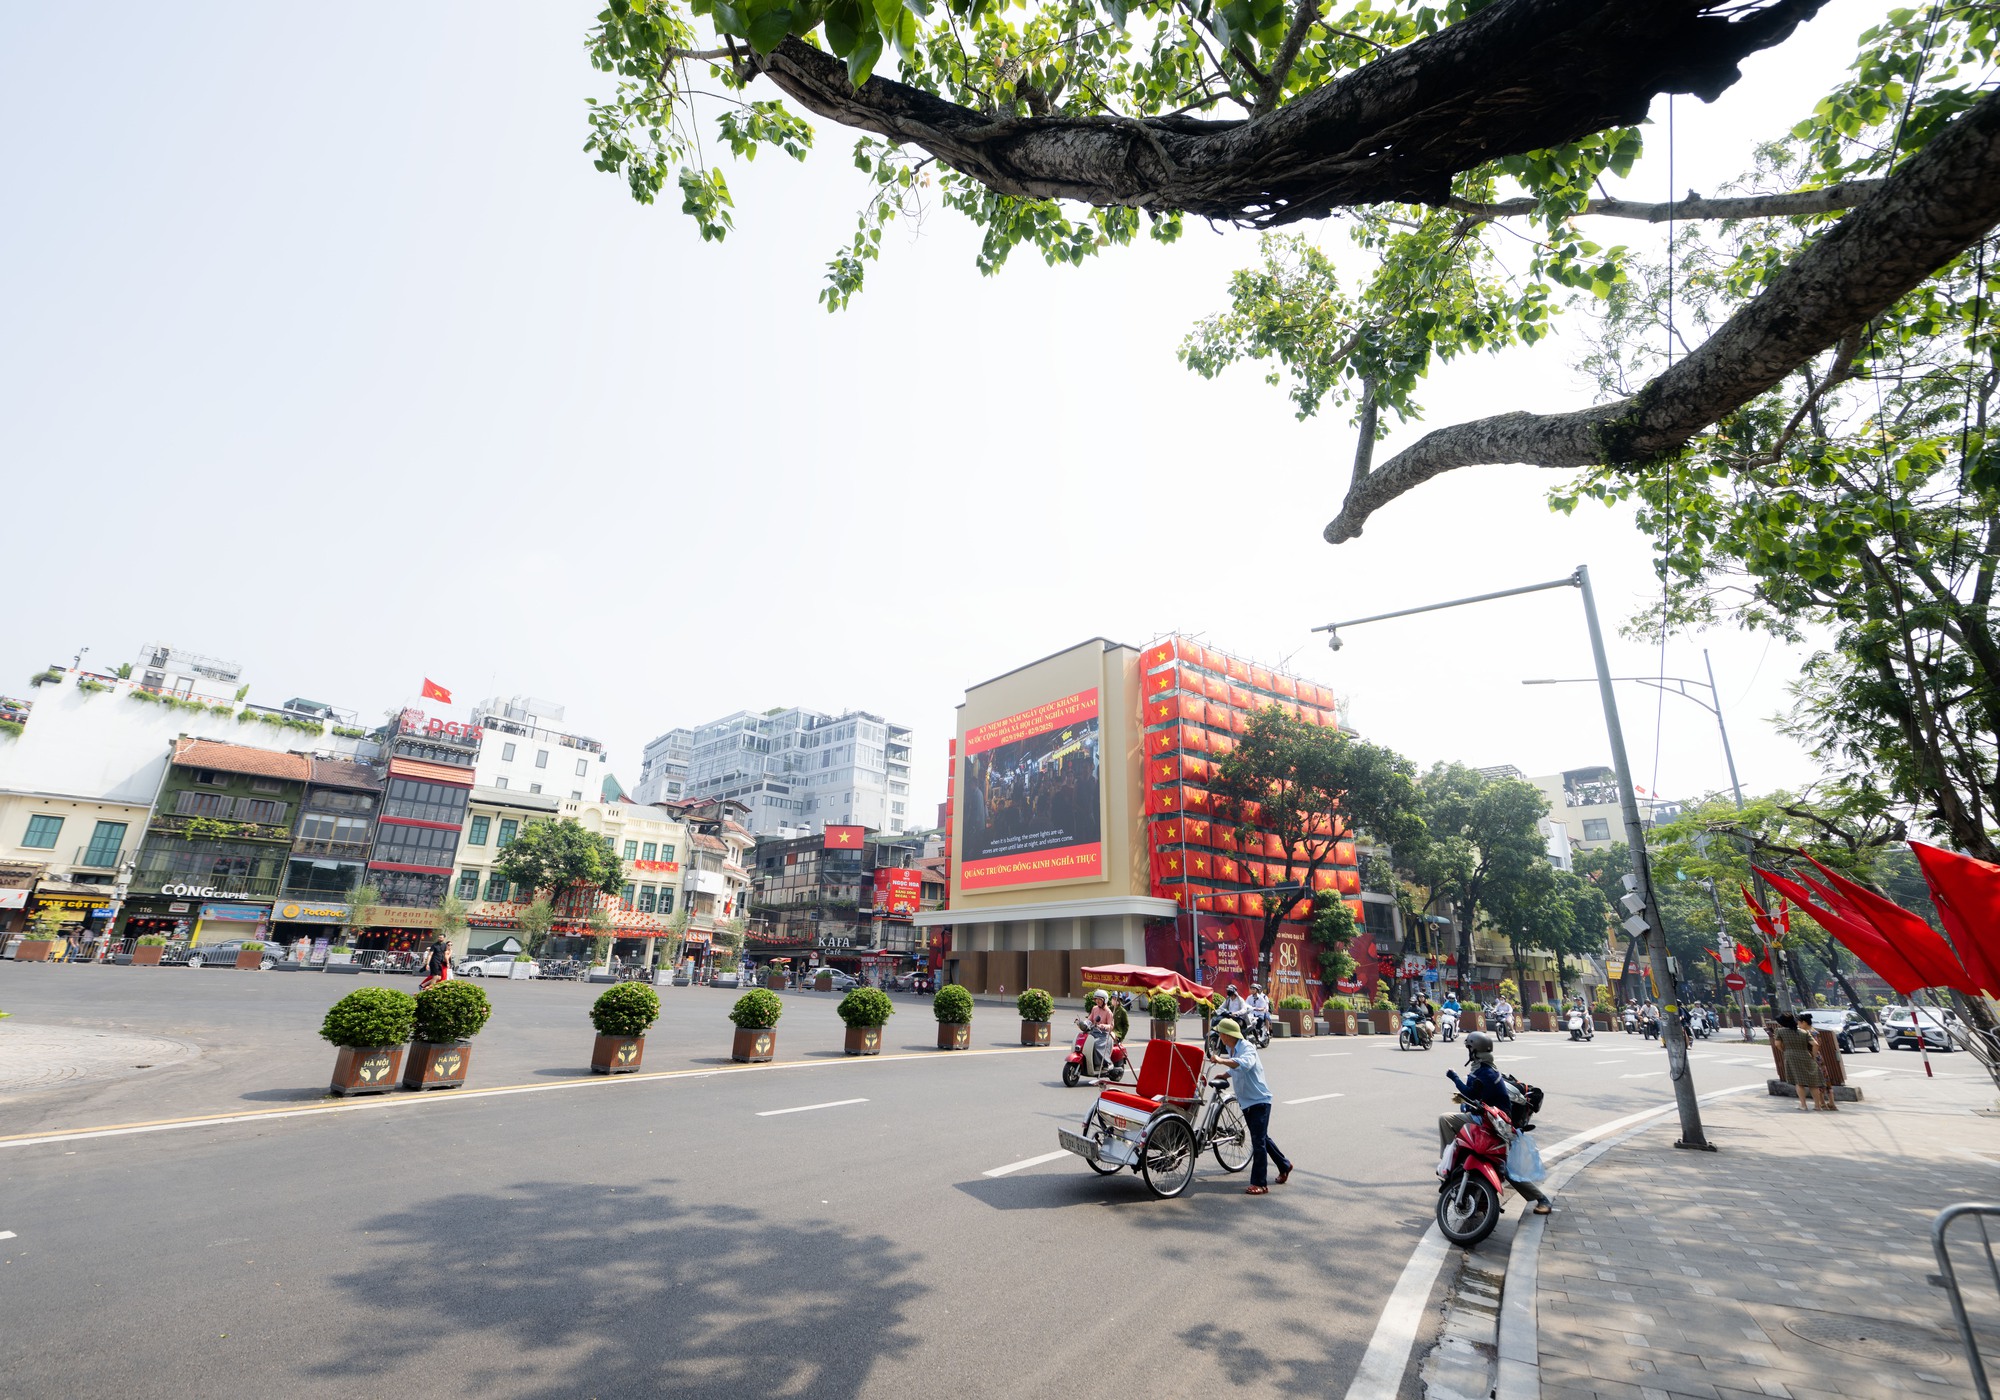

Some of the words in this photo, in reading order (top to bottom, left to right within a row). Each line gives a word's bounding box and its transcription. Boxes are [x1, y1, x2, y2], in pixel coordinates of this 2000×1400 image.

[1039, 700, 1056, 714] QUỐC
[1056, 696, 1079, 708] KHÁNH
[983, 731, 998, 740] CỘNG
[1044, 708, 1064, 720] NGHĨA
[1065, 704, 1080, 714] VIỆT
[1081, 698, 1096, 709] NAM
[428, 718, 484, 740] DGTS
[964, 868, 984, 879] QUẢNG
[986, 864, 1011, 875] TRƯỜNG
[1012, 861, 1031, 872] ĐÔNG
[1033, 860, 1050, 869] KINH
[1051, 855, 1074, 866] NGHĨA
[1076, 854, 1096, 864] THỤC
[161, 883, 214, 897] CỘNG
[818, 937, 850, 948] KAFA
[1280, 942, 1298, 968] 80
[364, 1059, 375, 1067] HÀ
[376, 1058, 389, 1068] NỘI
[448, 1054, 460, 1063] NỘI
